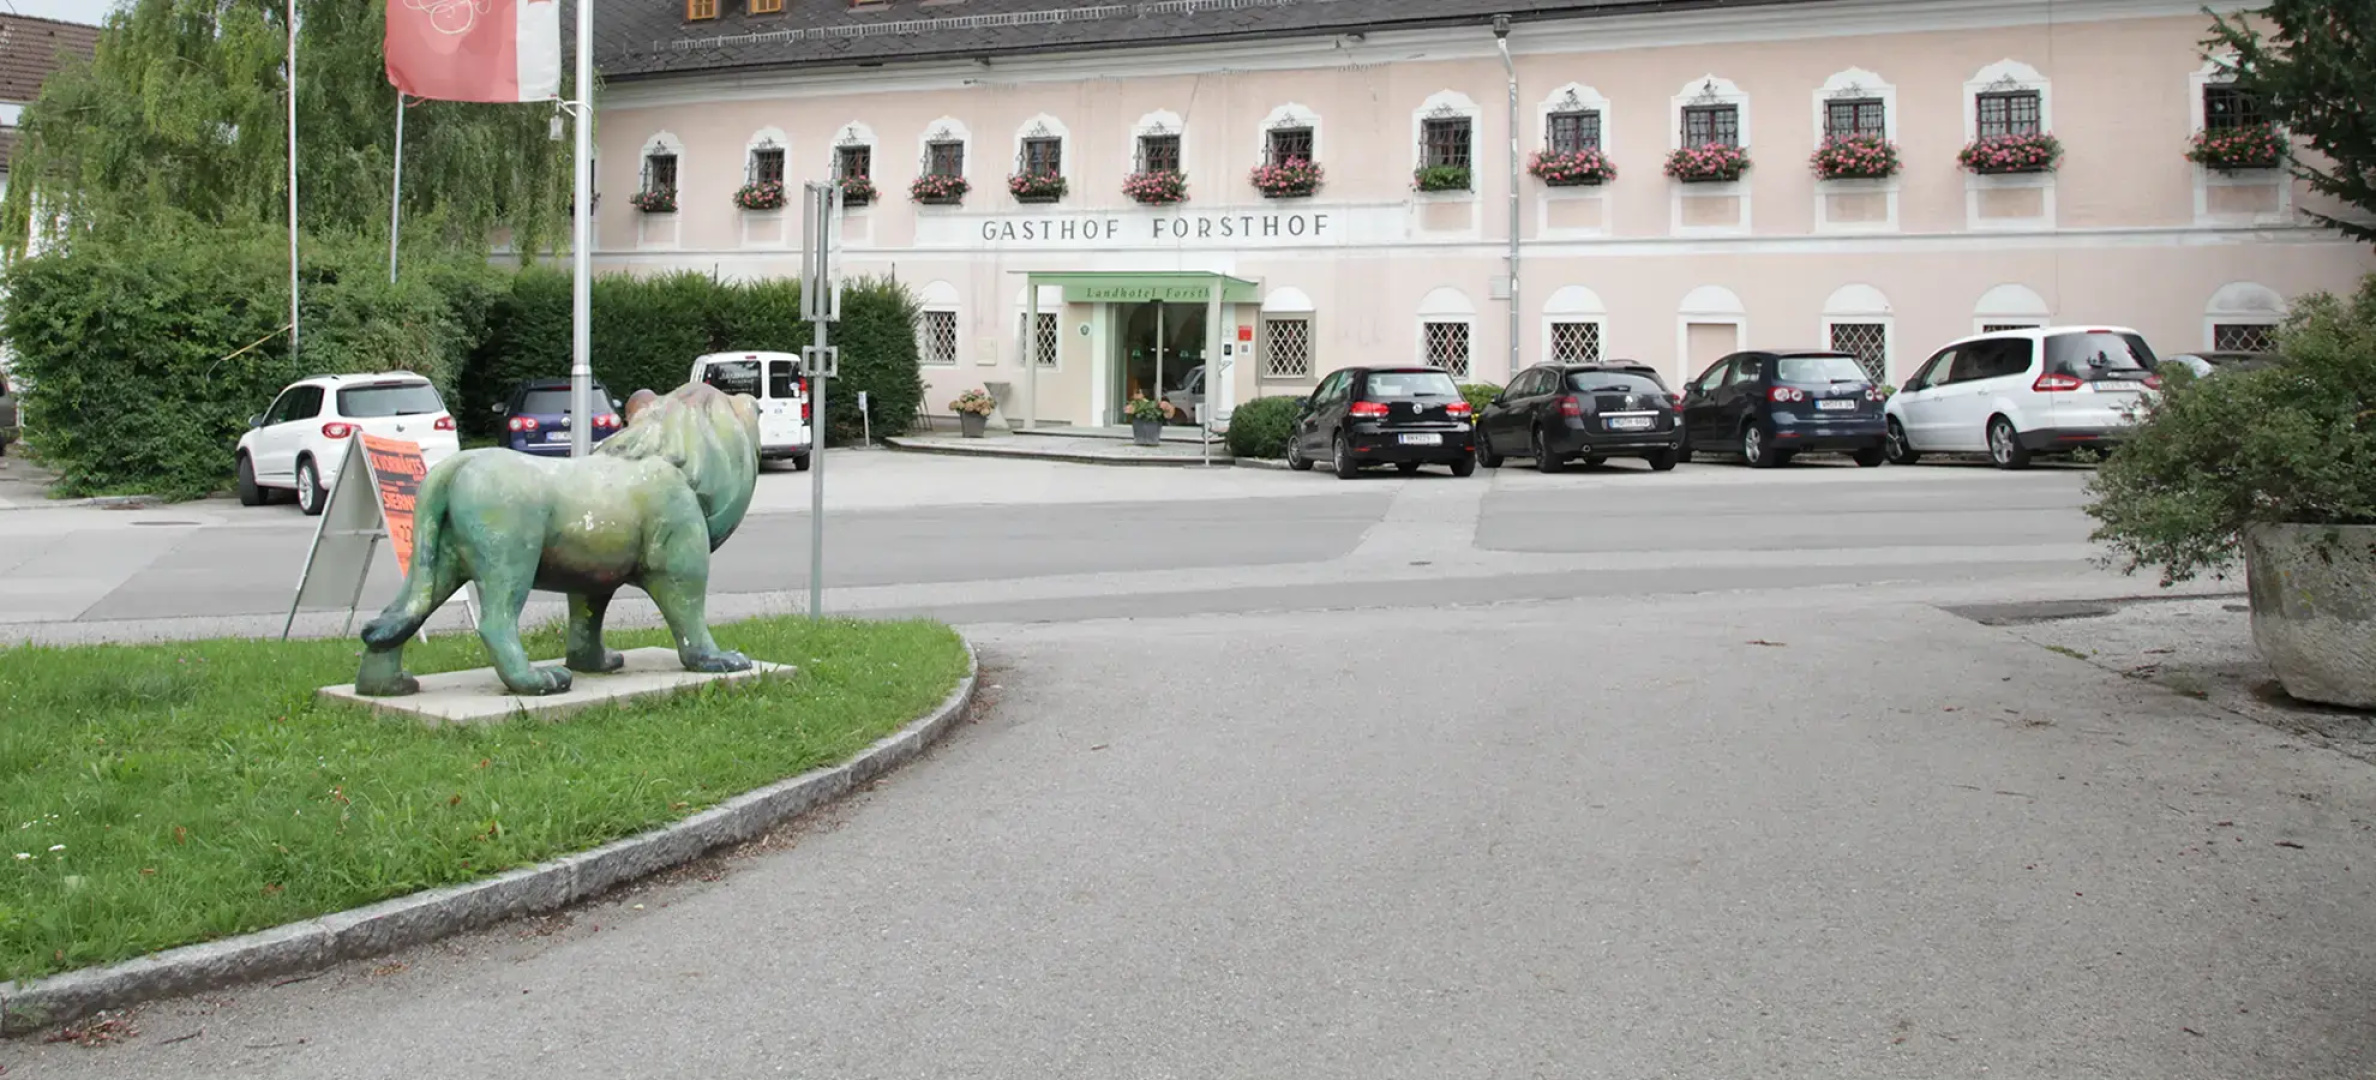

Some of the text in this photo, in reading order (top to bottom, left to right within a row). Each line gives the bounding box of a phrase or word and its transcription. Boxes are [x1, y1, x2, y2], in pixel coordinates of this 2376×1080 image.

[982, 213, 1329, 241] GASTHOF FORSTHOF
[1086, 287, 1229, 301] Landhotel Forsthf
